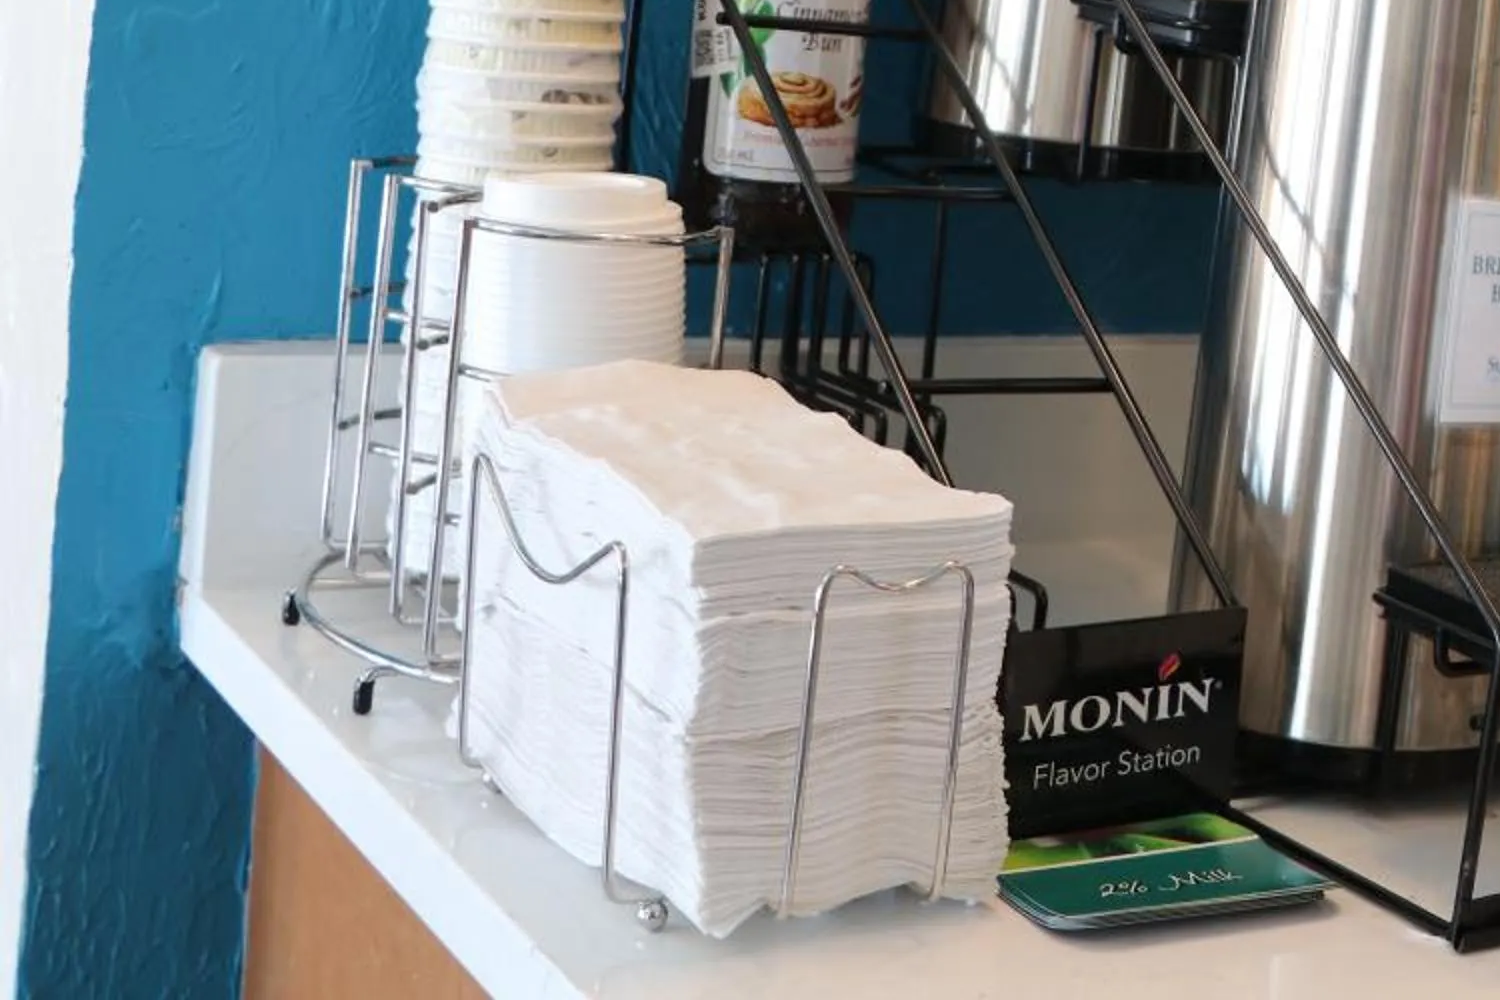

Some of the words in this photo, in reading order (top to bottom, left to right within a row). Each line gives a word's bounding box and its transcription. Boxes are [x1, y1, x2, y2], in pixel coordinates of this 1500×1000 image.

[1017, 676, 1216, 743] MONIN
[1032, 760, 1111, 791] Flavor
[1117, 744, 1201, 777] Station
[1099, 880, 1149, 898] 2%
[1158, 867, 1244, 892] Milk
